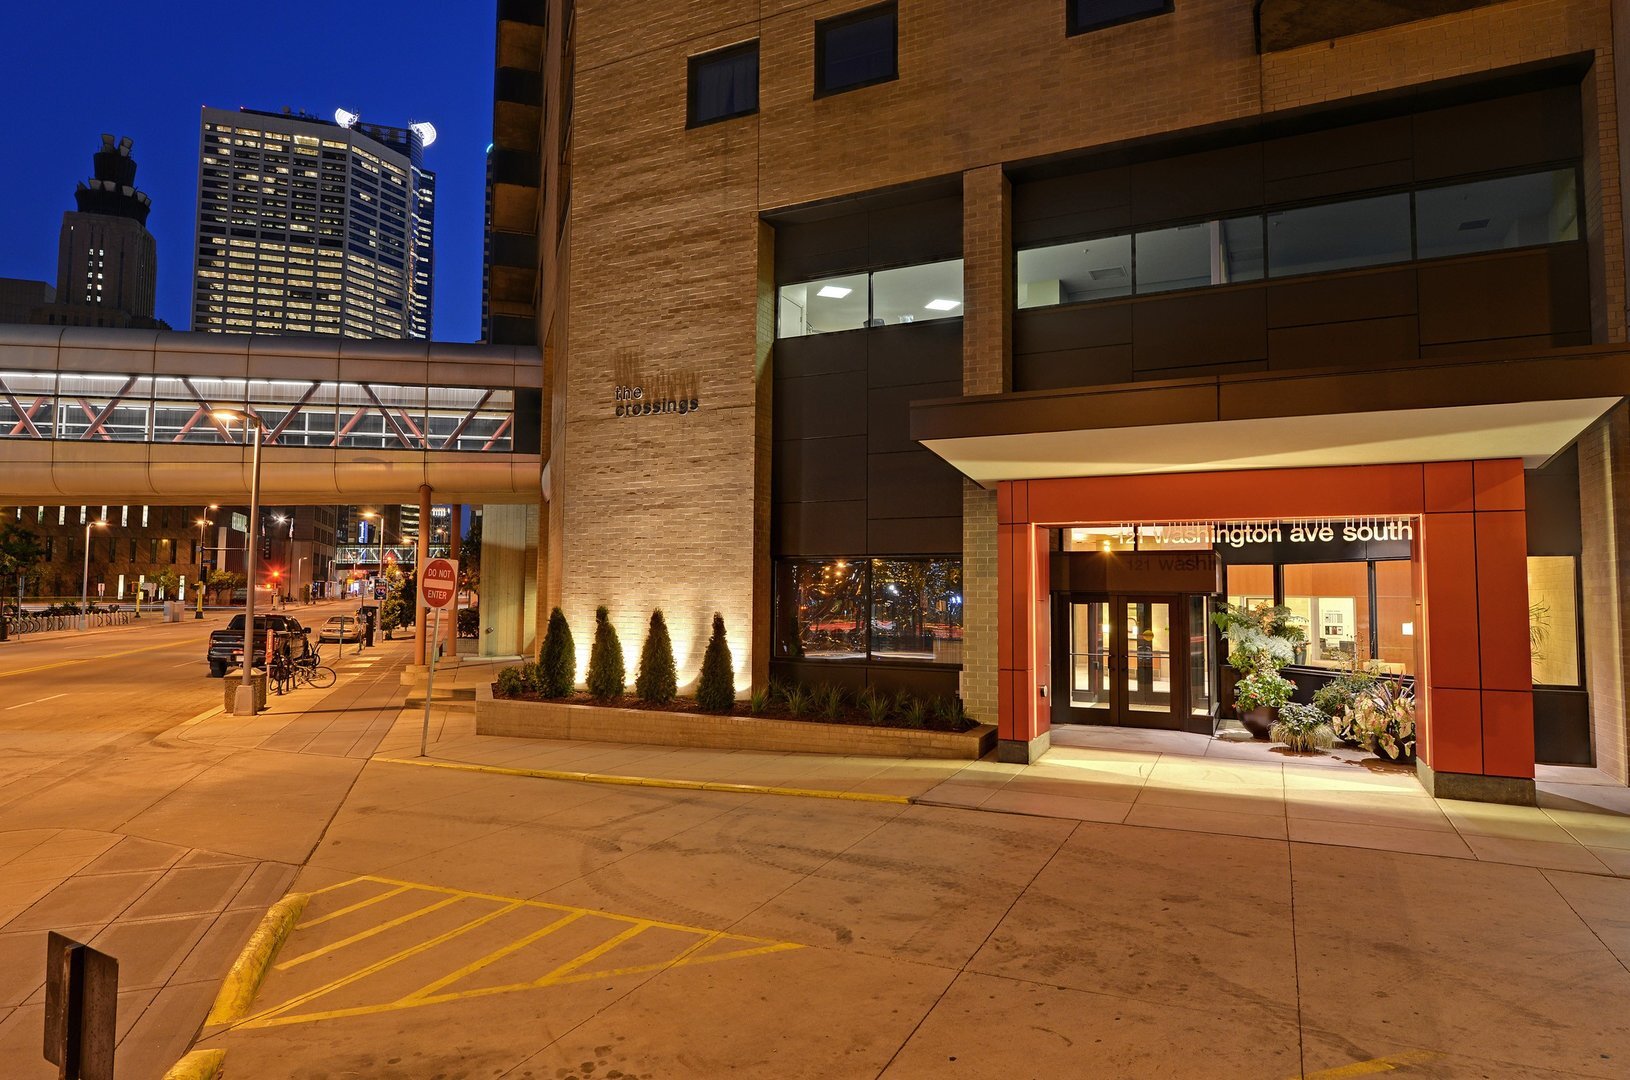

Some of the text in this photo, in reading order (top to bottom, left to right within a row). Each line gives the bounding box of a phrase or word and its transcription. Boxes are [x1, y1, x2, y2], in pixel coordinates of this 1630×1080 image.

[614, 386, 643, 401] the
[615, 398, 699, 417] crossings
[1118, 520, 1413, 548] 121 washington ave south
[1158, 553, 1216, 572] washi
[428, 568, 451, 579] DO NOT
[427, 589, 448, 600] ENTER
